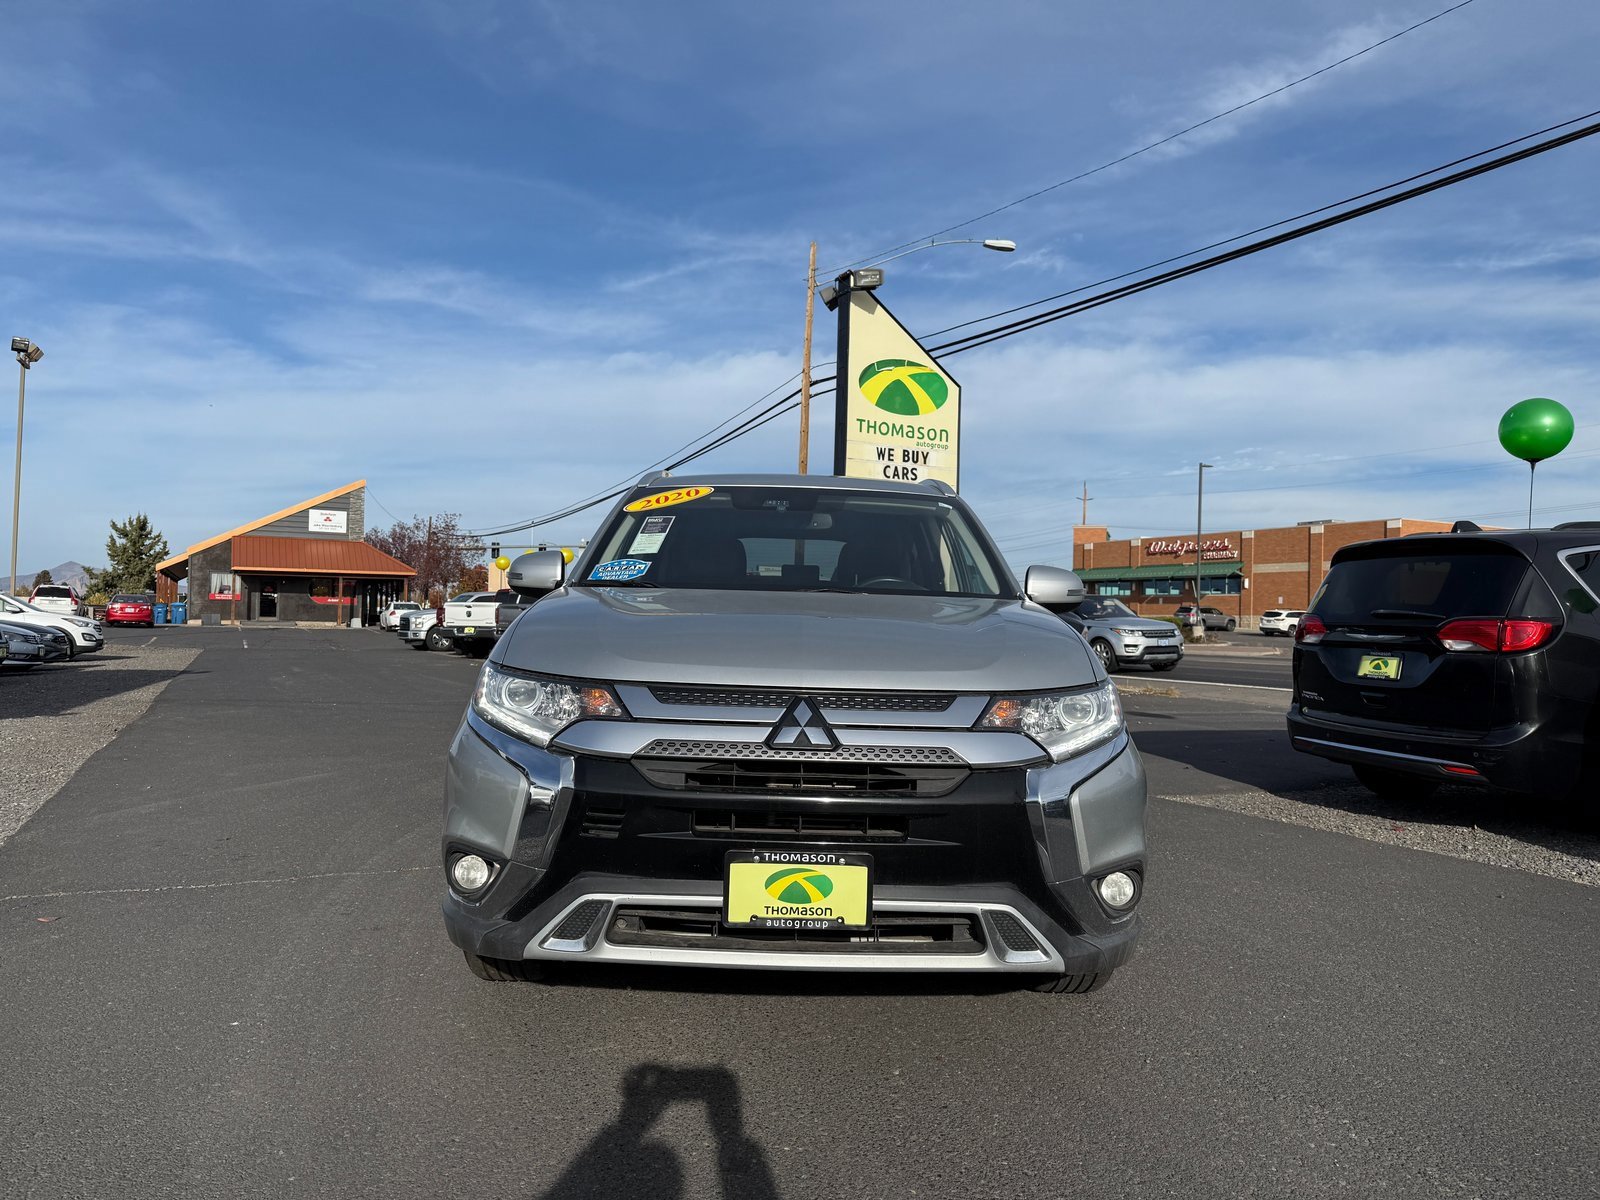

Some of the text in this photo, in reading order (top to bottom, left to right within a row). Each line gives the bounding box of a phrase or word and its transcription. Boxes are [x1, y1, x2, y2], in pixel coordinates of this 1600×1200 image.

[915, 441, 949, 450] autogroup
[876, 446, 930, 465] WE BUY
[883, 465, 918, 481] CARS
[639, 488, 700, 510] 2020
[766, 918, 829, 929] autogroup
